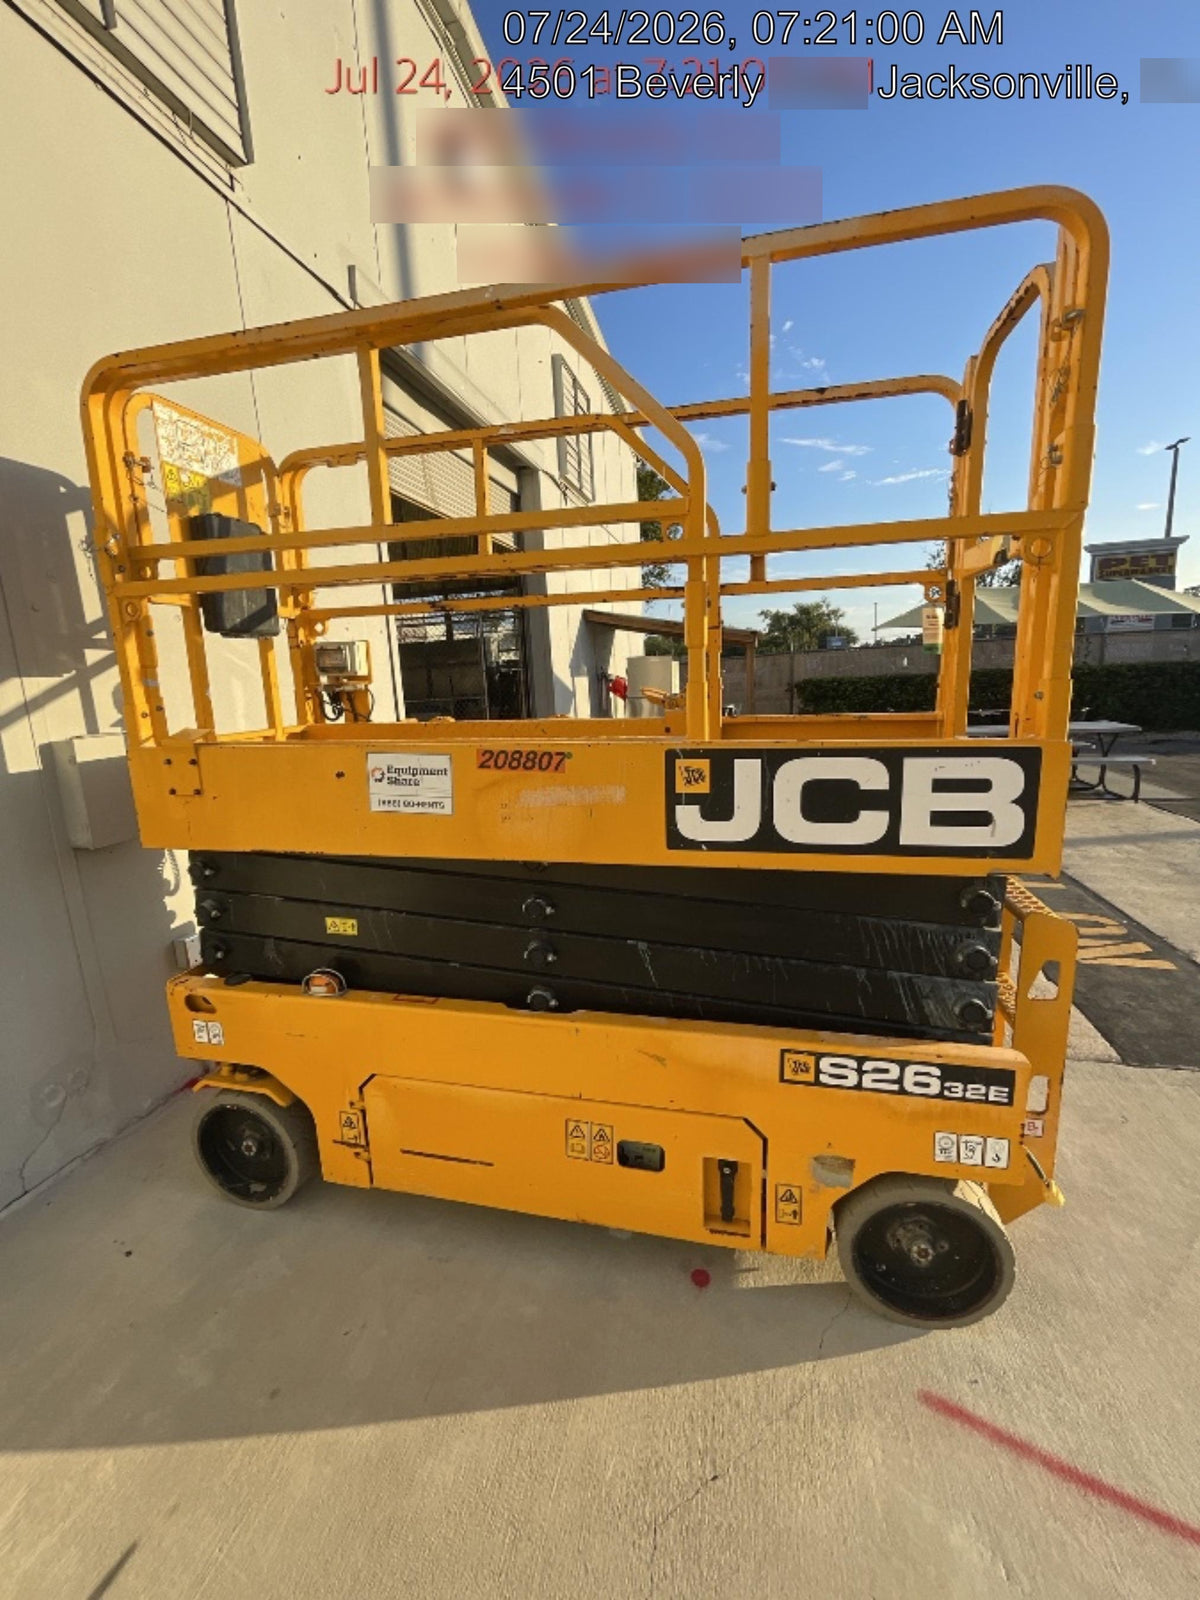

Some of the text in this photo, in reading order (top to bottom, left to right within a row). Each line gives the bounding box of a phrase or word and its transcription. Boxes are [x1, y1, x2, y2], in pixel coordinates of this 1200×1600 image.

[478, 750, 567, 772] 208807
[386, 764, 449, 778] Equipment
[386, 776, 421, 787] Share
[674, 756, 1026, 847] JCB
